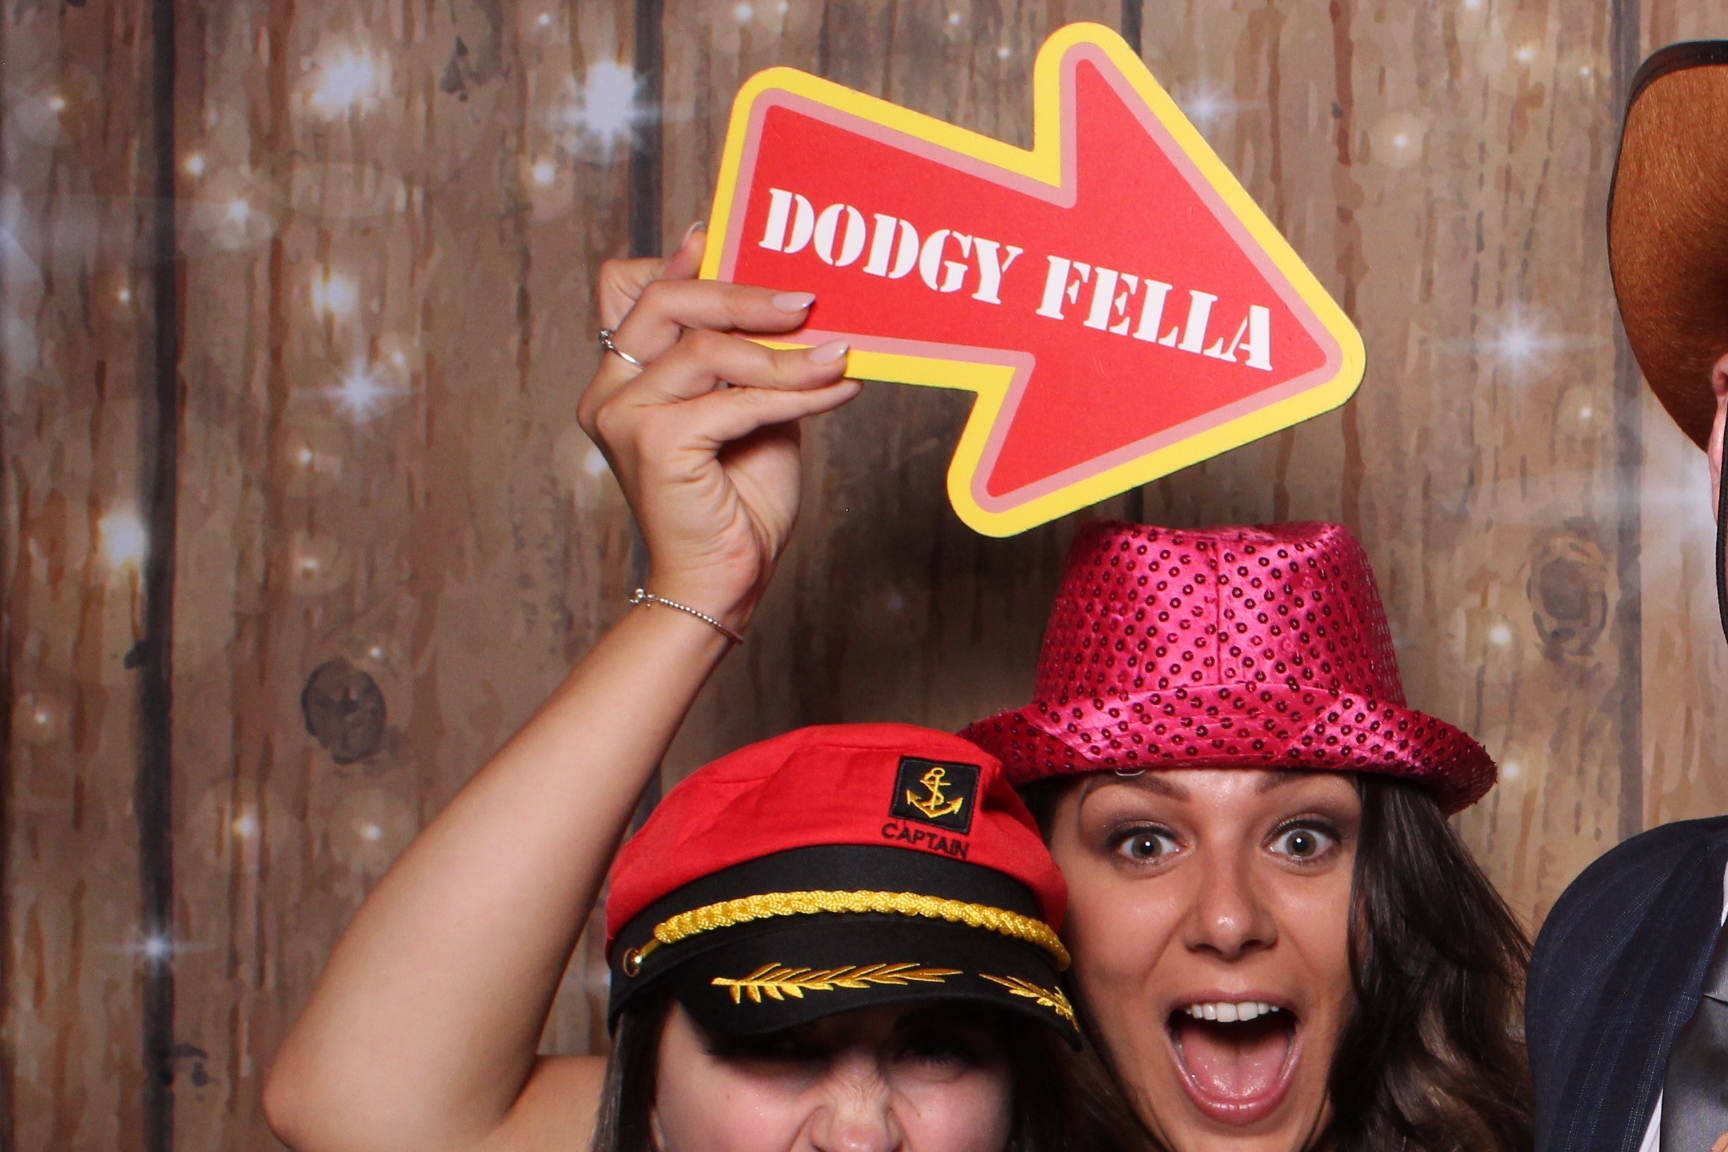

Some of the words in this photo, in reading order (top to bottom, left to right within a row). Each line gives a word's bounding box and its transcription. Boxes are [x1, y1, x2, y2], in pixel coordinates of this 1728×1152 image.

[758, 187, 1023, 305] DODGY
[1035, 253, 1273, 371] FELLA
[881, 823, 970, 859] CAPTAIN
